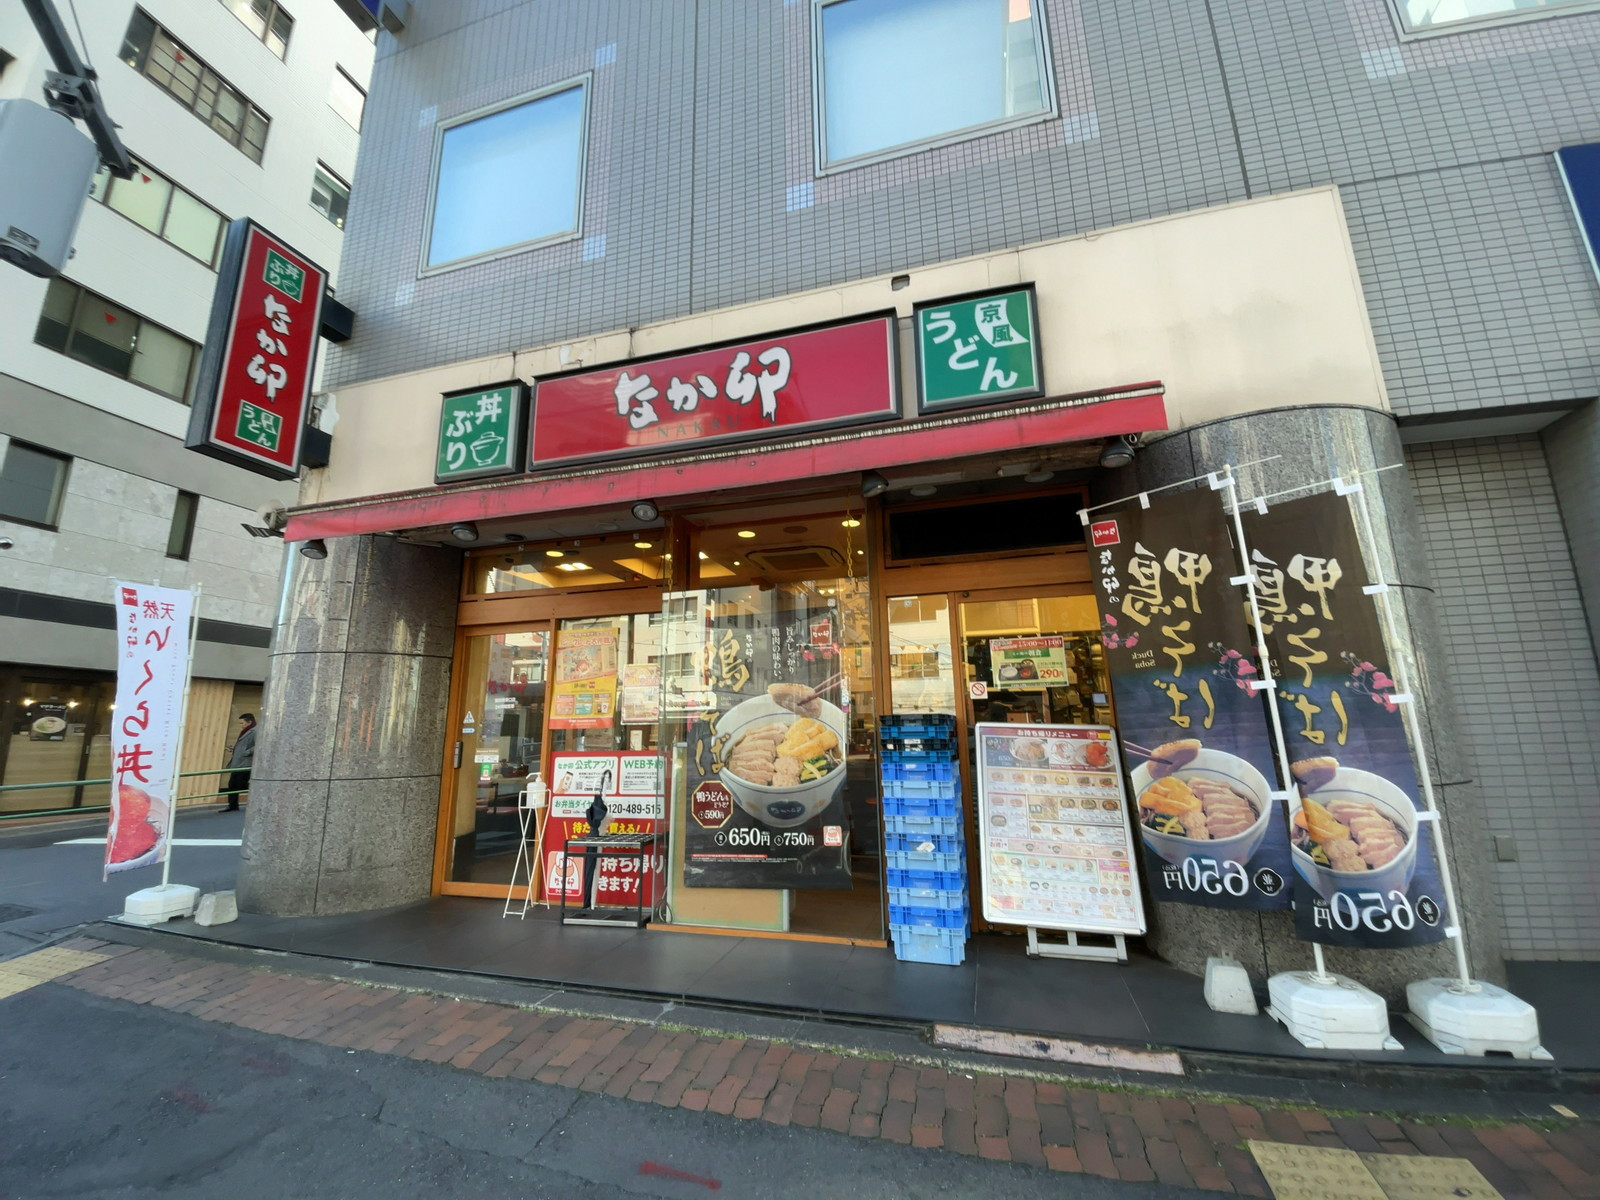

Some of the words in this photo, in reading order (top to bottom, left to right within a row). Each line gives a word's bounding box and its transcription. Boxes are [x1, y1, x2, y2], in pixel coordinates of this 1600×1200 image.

[980, 304, 1014, 345] 京風
[247, 293, 292, 403] なか卯
[925, 310, 1018, 391] うどん
[613, 346, 792, 430] なか卯
[242, 404, 272, 447] うどん
[445, 392, 502, 470] 丼ぶり
[656, 415, 742, 438] NAKAU
[1017, 729, 1079, 739] お持ち帰りメニュー
[575, 760, 615, 770] 公式アプリ
[623, 759, 664, 770] WEB予約
[728, 827, 771, 846] 650円
[783, 832, 815, 846] 750円
